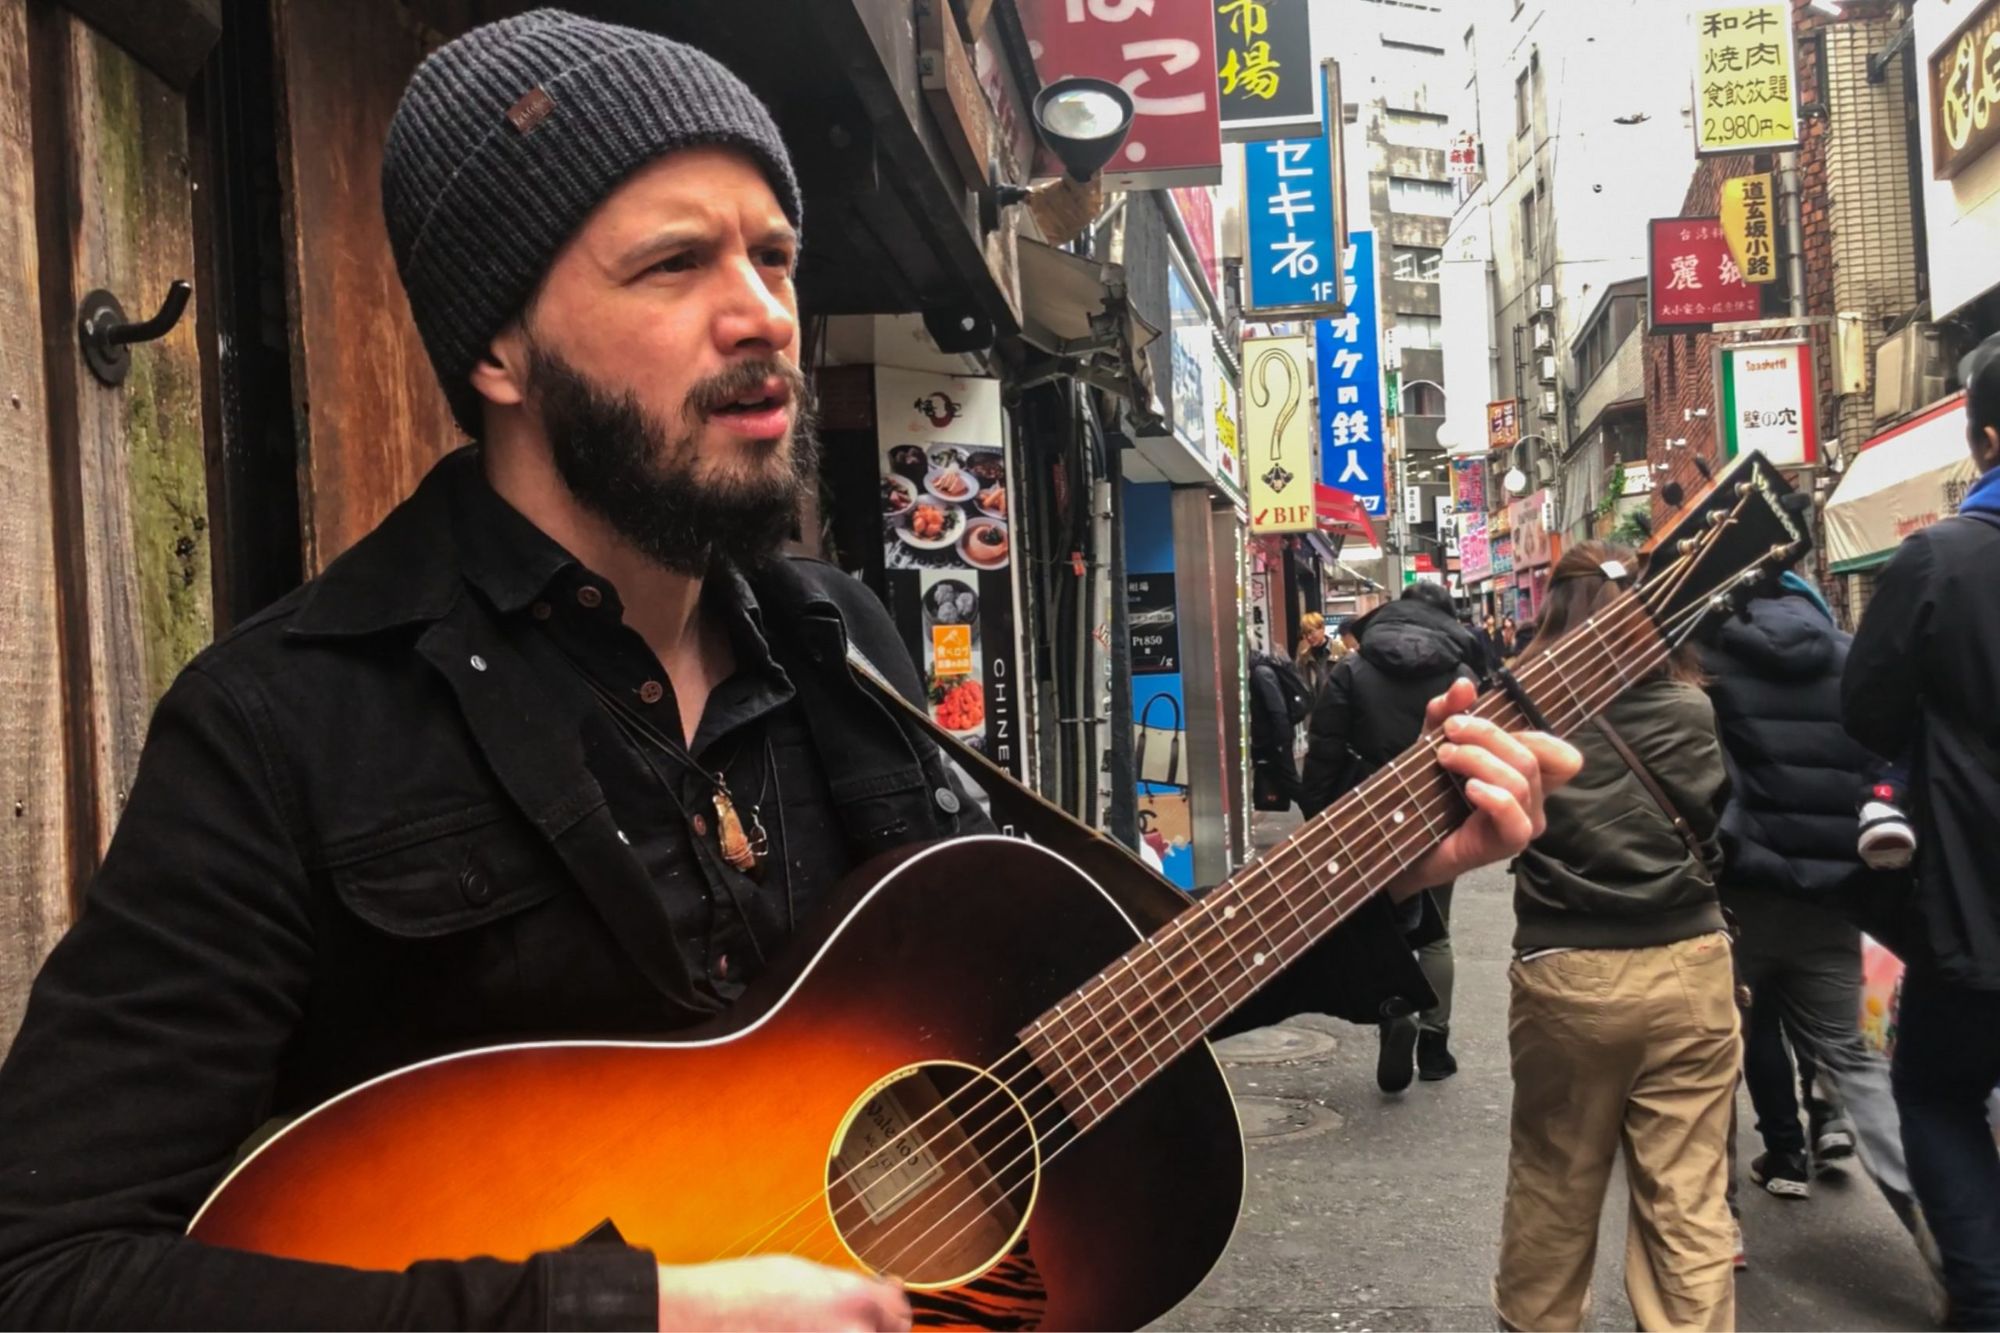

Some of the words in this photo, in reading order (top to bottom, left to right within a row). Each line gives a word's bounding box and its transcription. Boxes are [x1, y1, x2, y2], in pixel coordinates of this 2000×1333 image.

[1702, 8, 1778, 38] 和牛
[1218, 0, 1281, 100] 市場
[1704, 42, 1781, 74] 焼肉
[1703, 75, 1788, 108] 食飲放題
[1266, 140, 1319, 278] セキネ
[1742, 181, 1771, 276] 道玄坂小路
[1311, 282, 1332, 301] 1F
[1743, 407, 1798, 429] 壁の穴
[1273, 505, 1311, 524] B1F
[1132, 635, 1163, 647] Pt850
